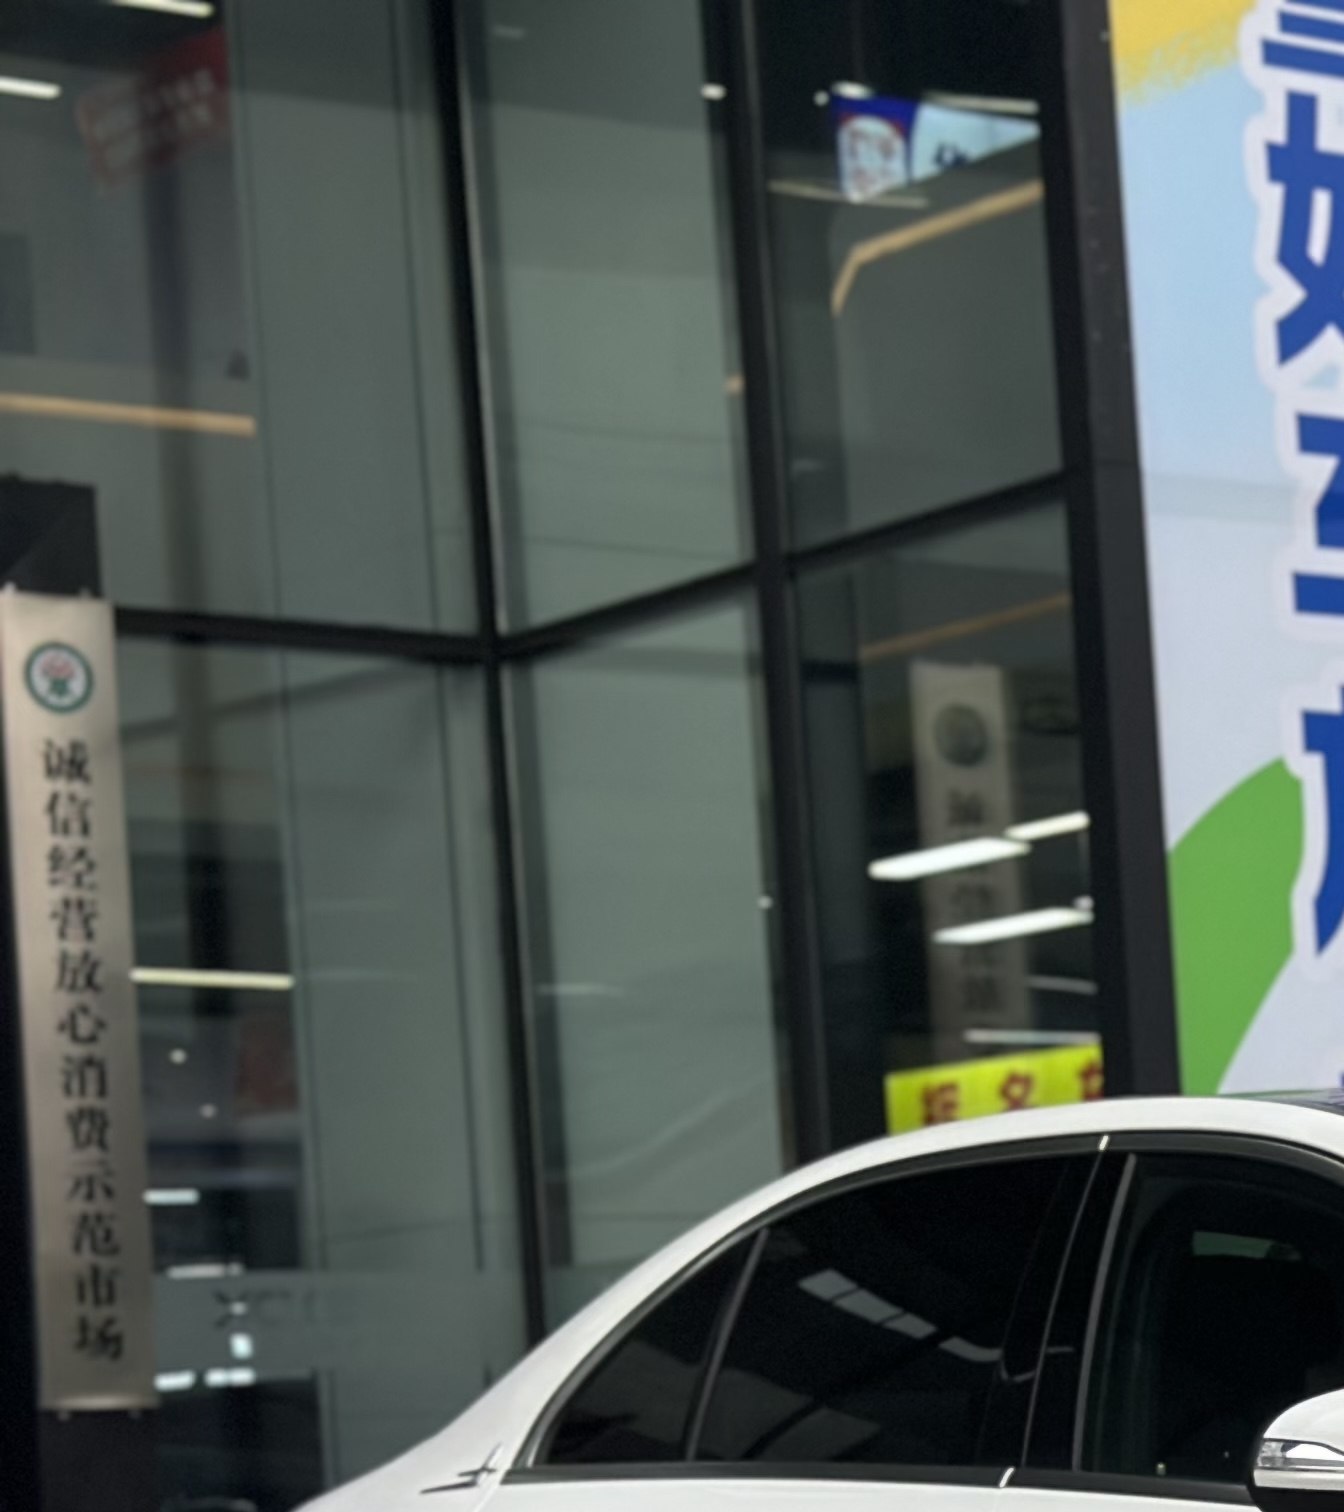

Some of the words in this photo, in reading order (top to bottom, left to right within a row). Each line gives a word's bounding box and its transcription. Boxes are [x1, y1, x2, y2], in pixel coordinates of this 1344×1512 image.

[42, 736, 125, 1361] 诚信经营放心消费示范市场
